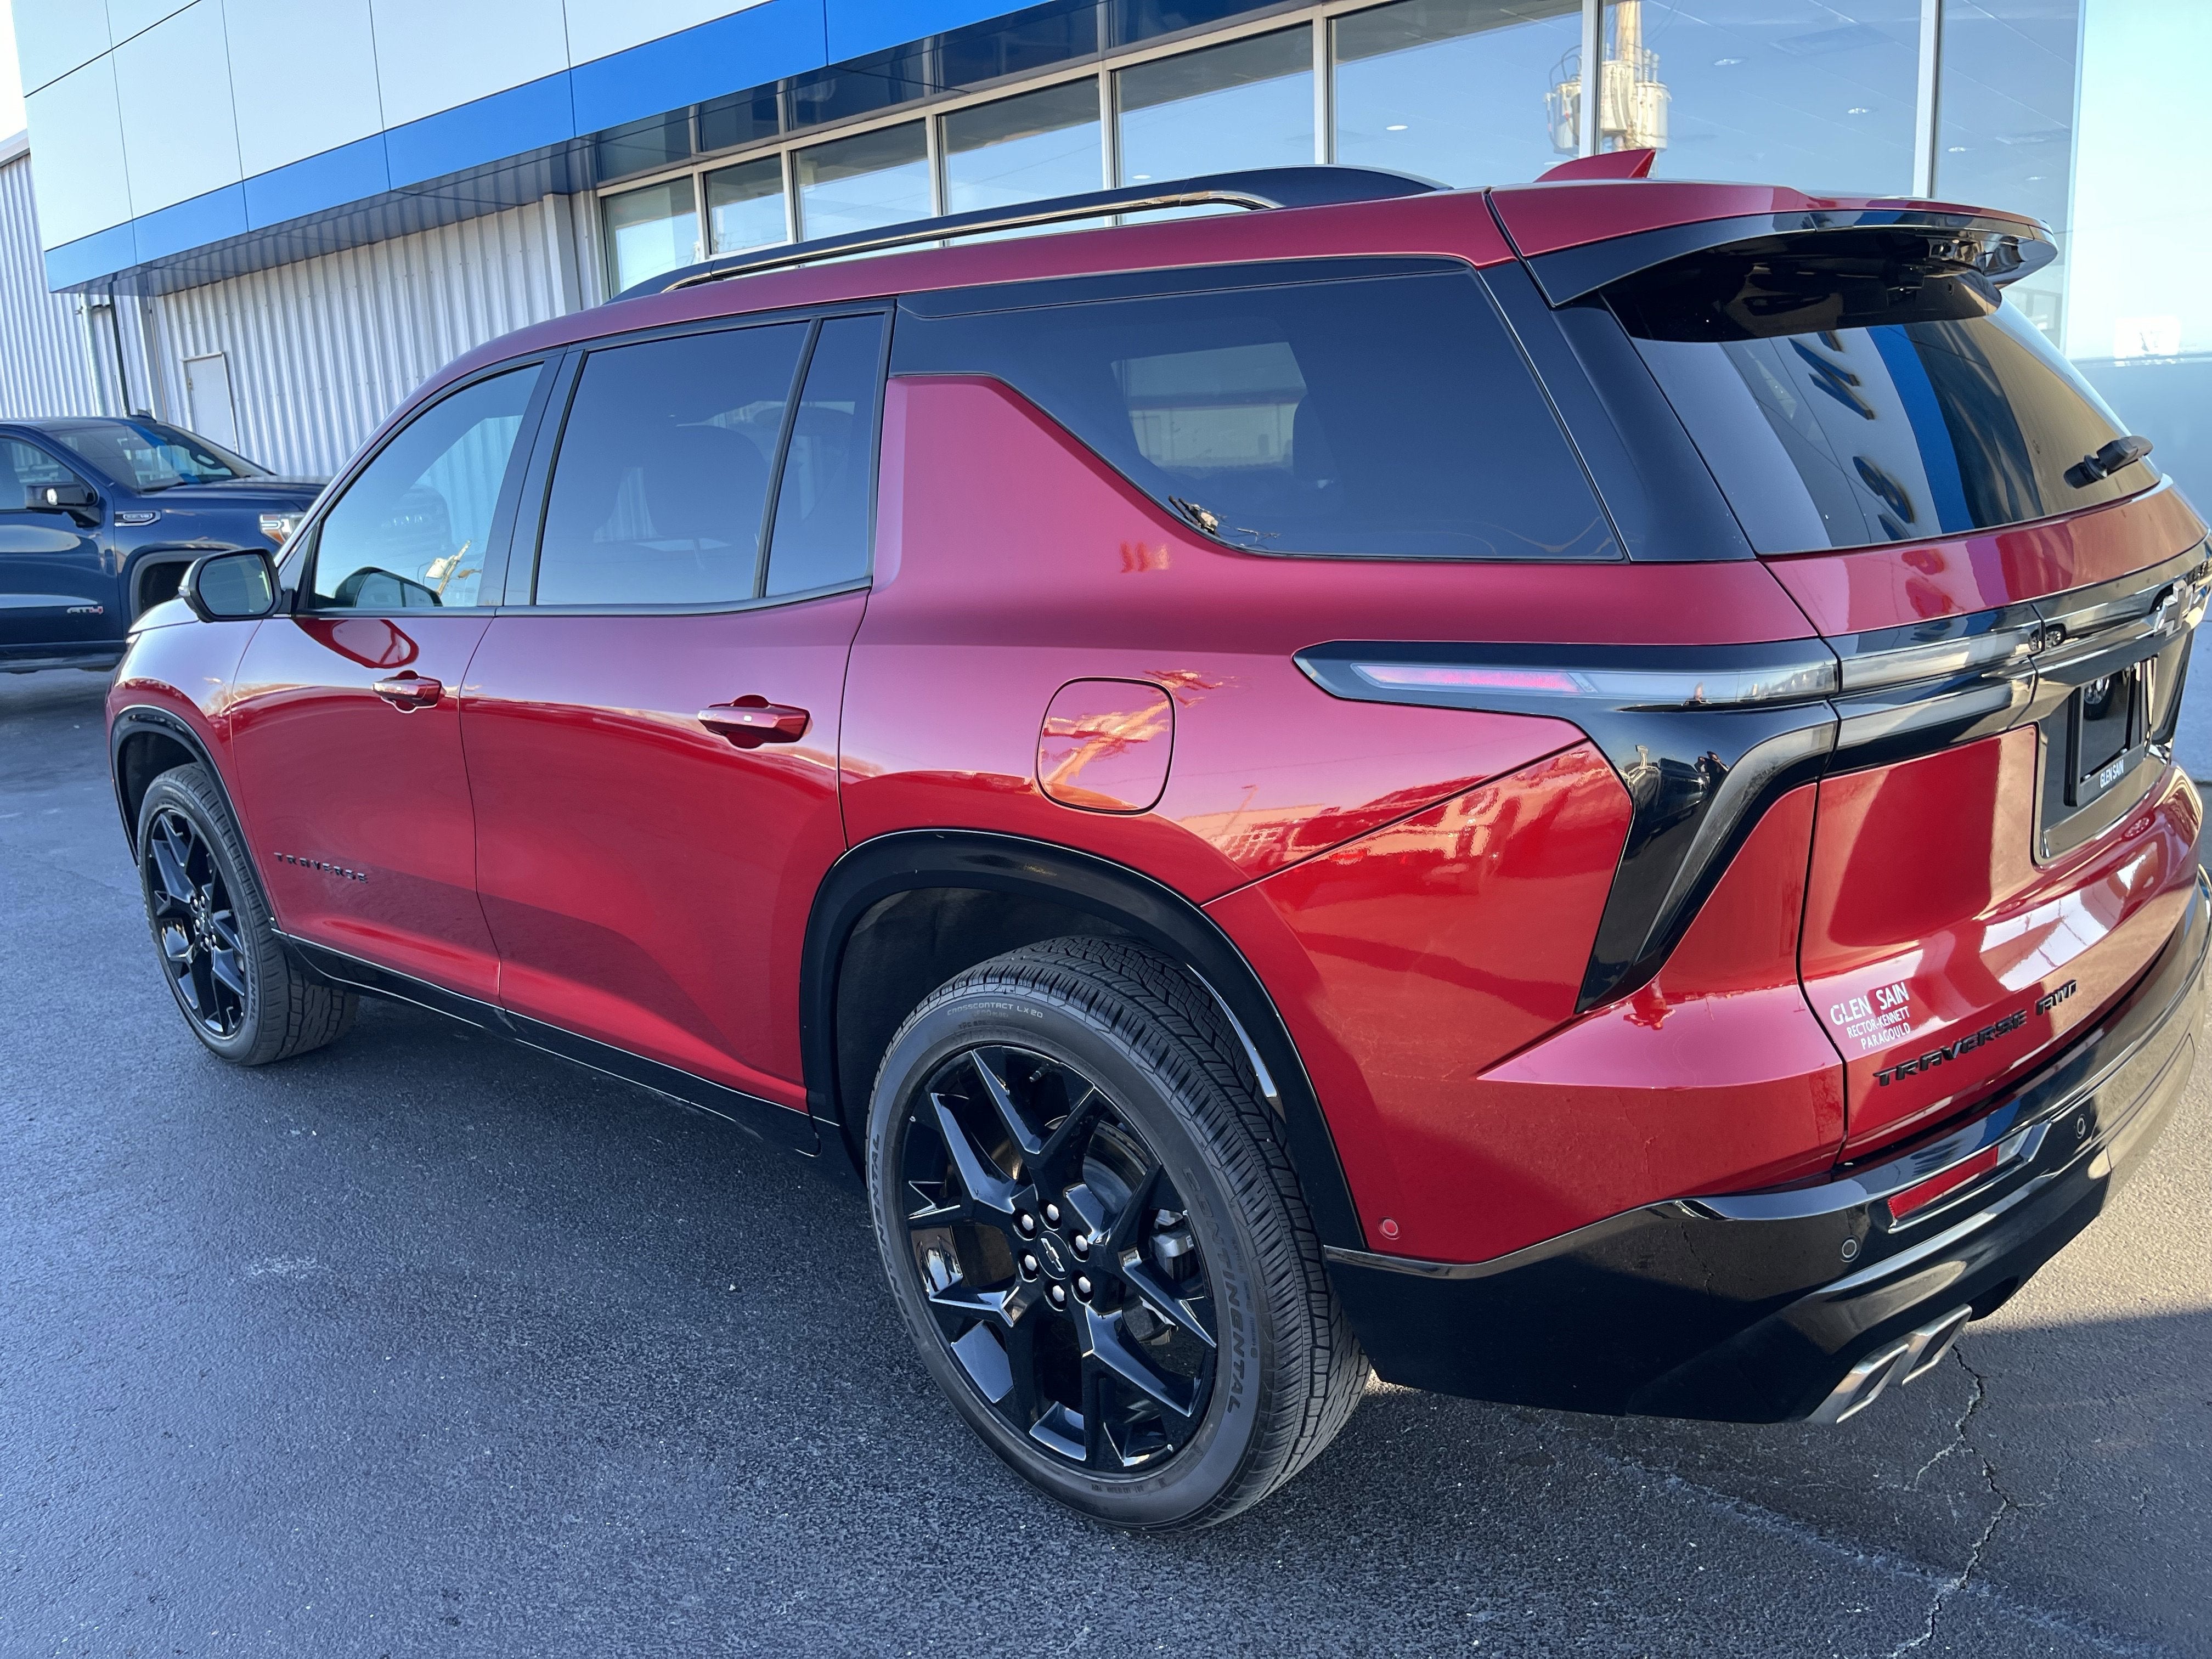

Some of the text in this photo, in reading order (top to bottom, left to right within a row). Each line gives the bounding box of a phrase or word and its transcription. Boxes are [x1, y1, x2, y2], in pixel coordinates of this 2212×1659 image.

[2100, 759, 2124, 788] GLEN SAIN
[274, 852, 368, 883] TRAVERSE
[947, 1002, 1014, 1015] CROSSCONTACT
[1830, 981, 1910, 1025] GLEN SAIN
[1846, 1006, 1910, 1039] RECTOR-KENNETT
[1860, 1022, 1911, 1050] PARAGOULD
[1873, 979, 2078, 1086] TRAVERSE AWD
[1182, 1167, 1245, 1414] CONTINENTAL
